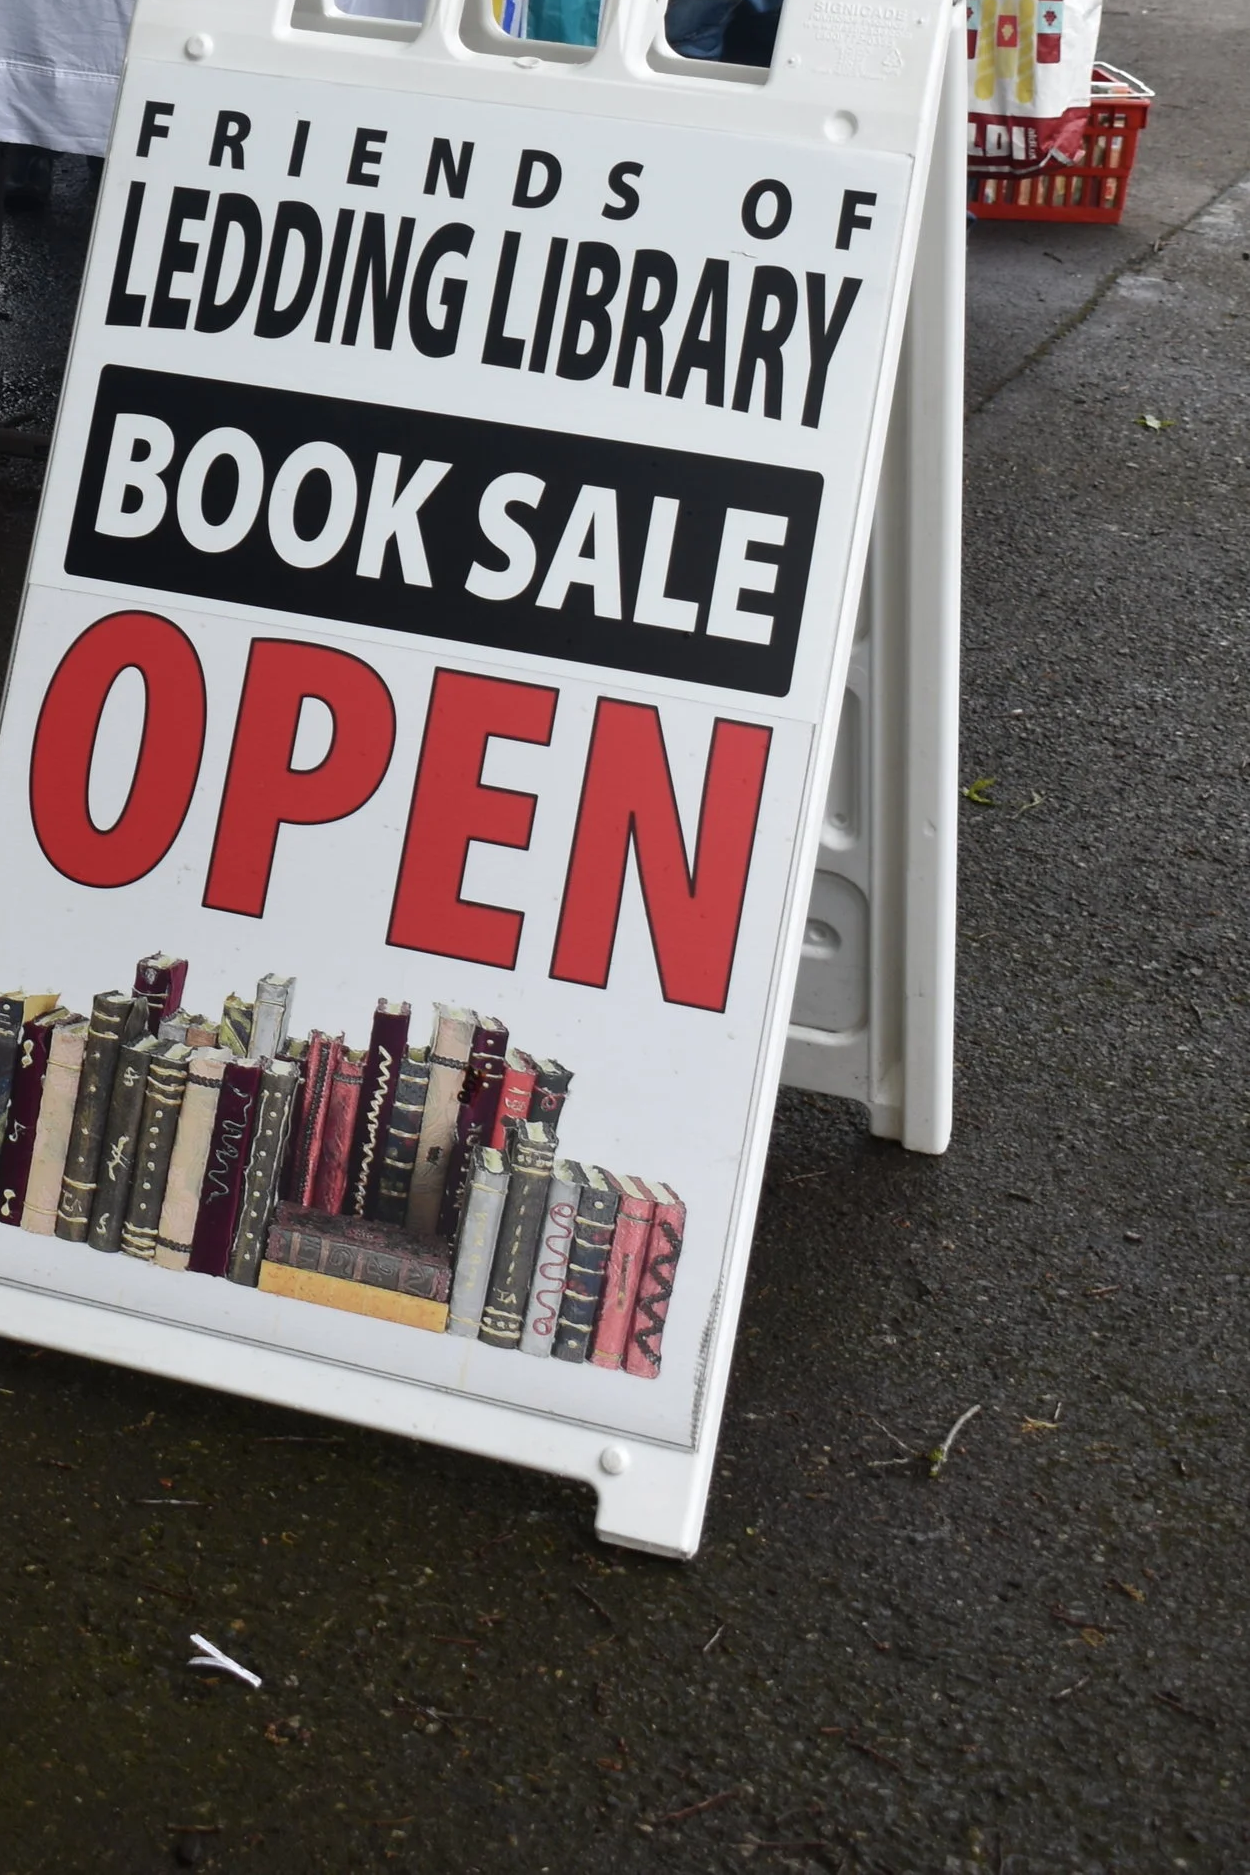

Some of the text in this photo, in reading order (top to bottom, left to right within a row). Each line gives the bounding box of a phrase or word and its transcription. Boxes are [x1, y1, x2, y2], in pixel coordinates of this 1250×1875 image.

[813, 0, 909, 23] SIGNICADE
[136, 101, 878, 252] FRIENDS OF
[967, 122, 1027, 161] LDI
[105, 181, 864, 430] LEDDING LIBRARY
[94, 412, 790, 646] BOOK SALE
[29, 609, 774, 1014] OPEN
